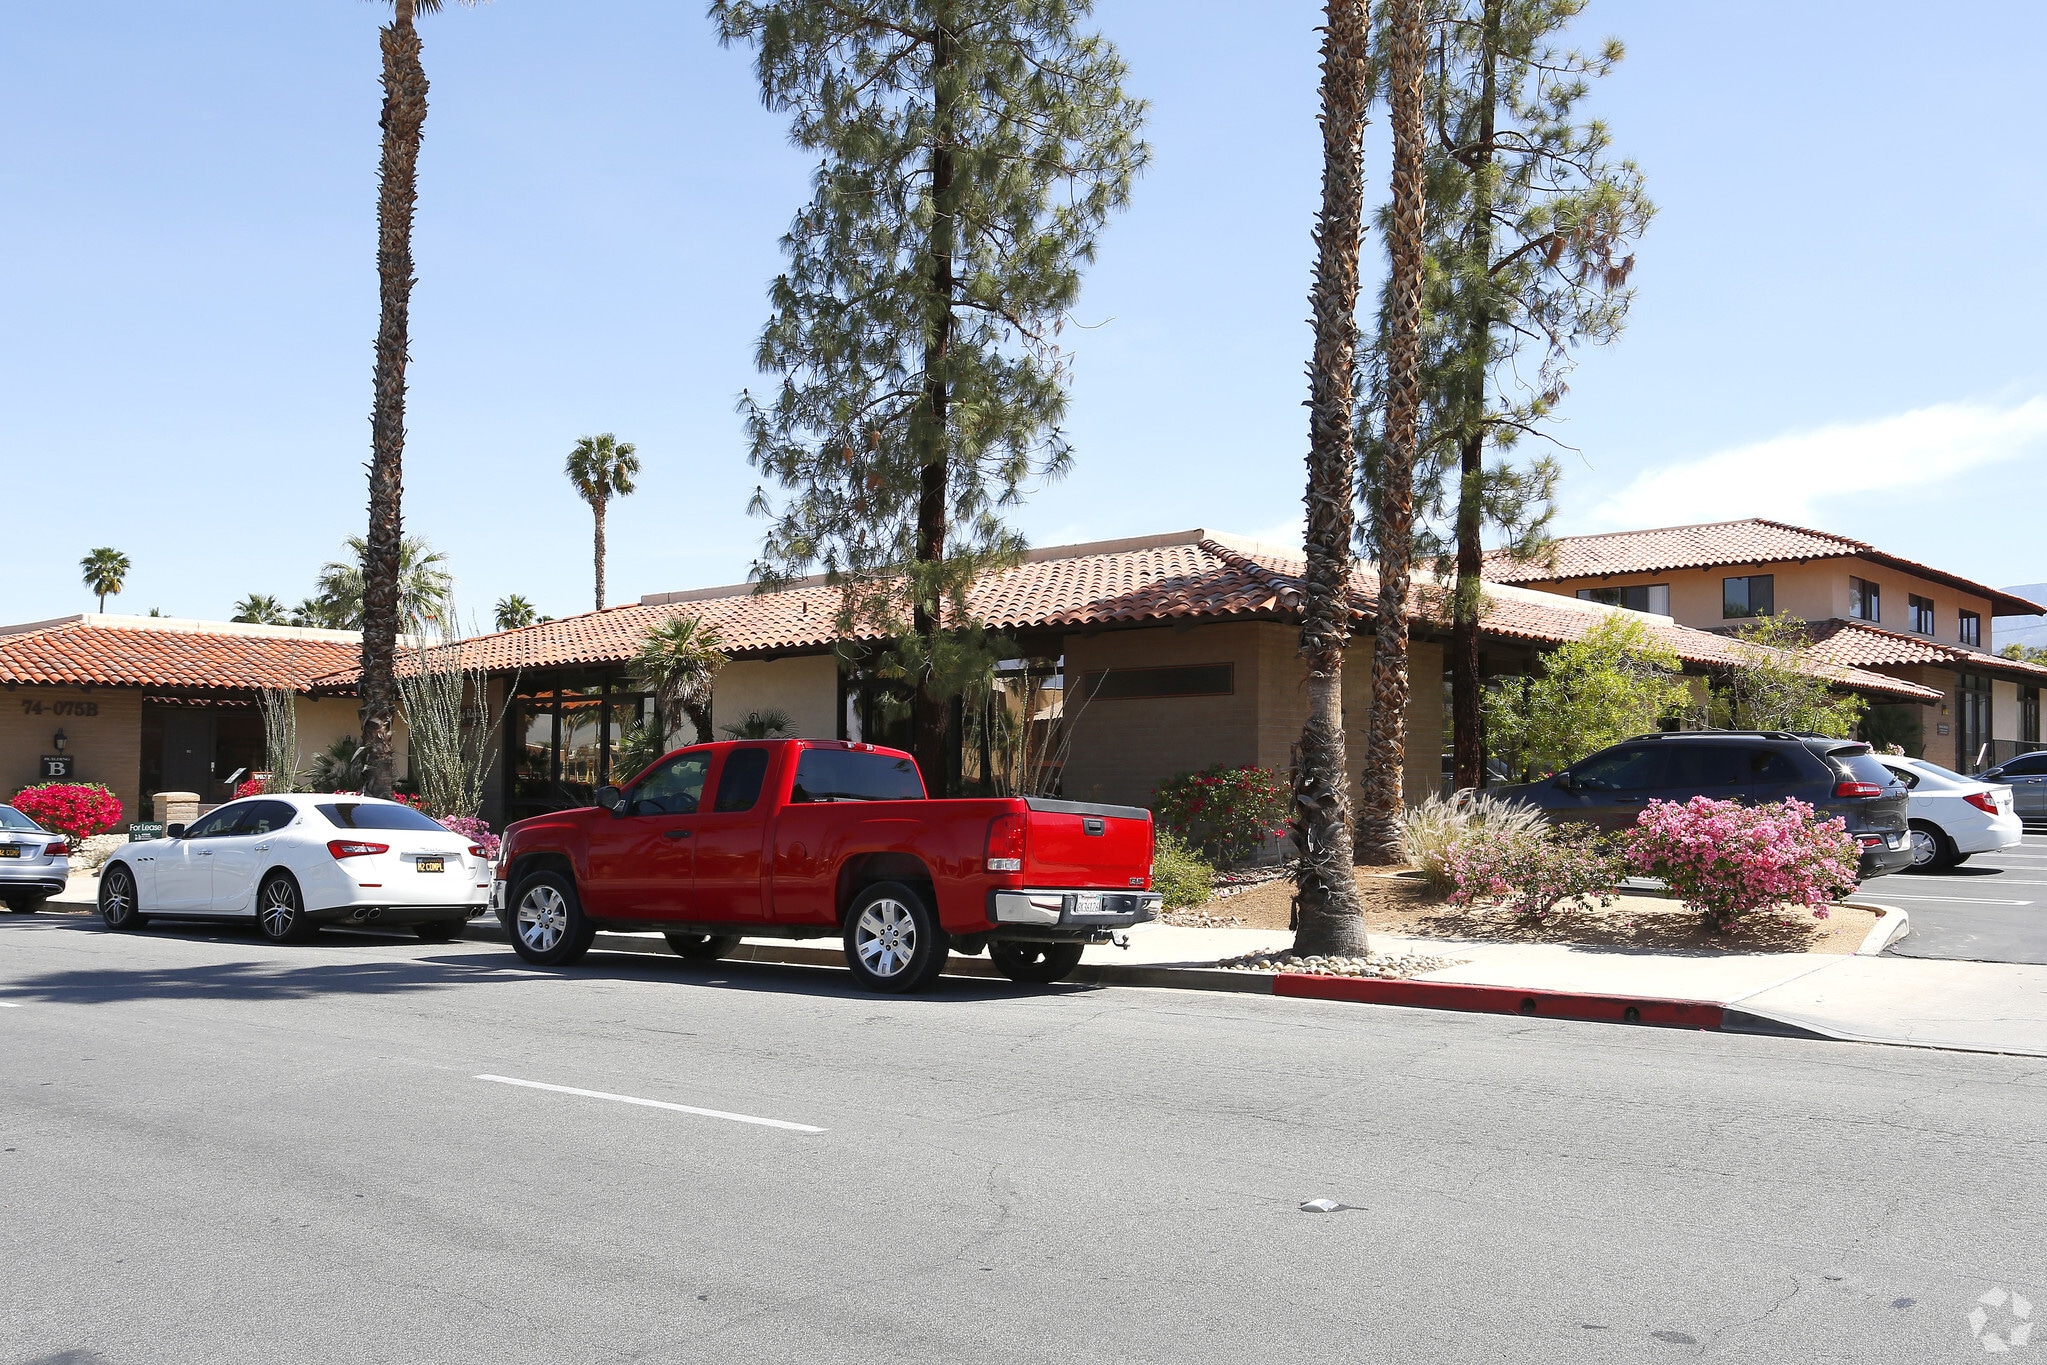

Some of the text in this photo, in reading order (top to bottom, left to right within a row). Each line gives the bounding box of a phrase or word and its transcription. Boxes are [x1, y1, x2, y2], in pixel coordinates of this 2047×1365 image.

[22, 699, 98, 716] 74-075B
[48, 761, 66, 776] B
[129, 823, 163, 831] For Lease
